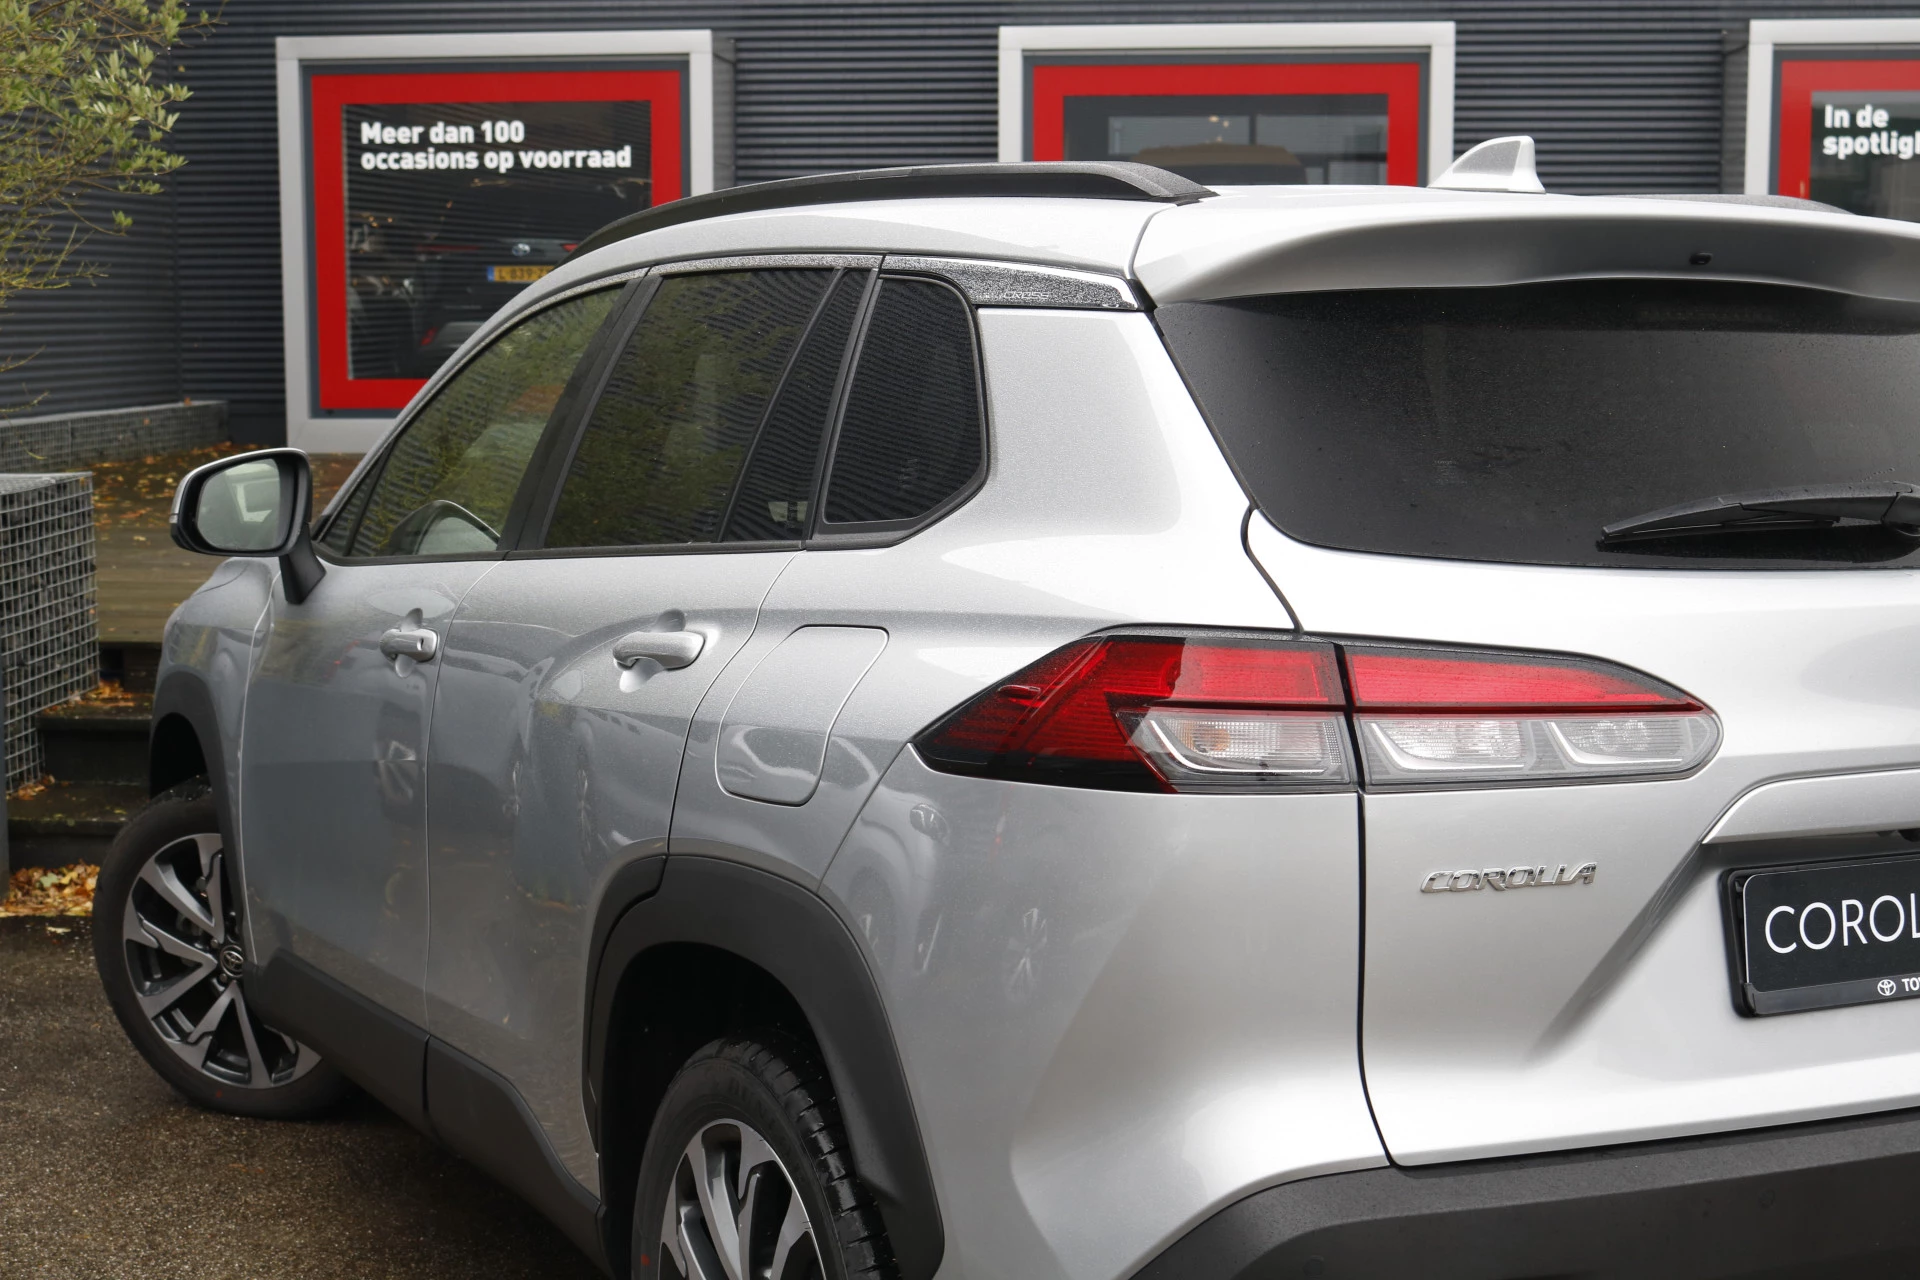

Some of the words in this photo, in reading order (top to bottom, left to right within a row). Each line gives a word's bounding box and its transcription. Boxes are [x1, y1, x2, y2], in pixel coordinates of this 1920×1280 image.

[1824, 104, 1850, 128] In
[1855, 104, 1889, 128] de
[360, 121, 425, 144] Meer
[429, 121, 475, 144] dan
[480, 120, 525, 143] 100
[360, 147, 480, 170] occasions
[483, 151, 515, 174] op
[518, 145, 632, 169] voorraad
[1420, 862, 1597, 893] COROLLA
[1901, 976, 1920, 992] TO
